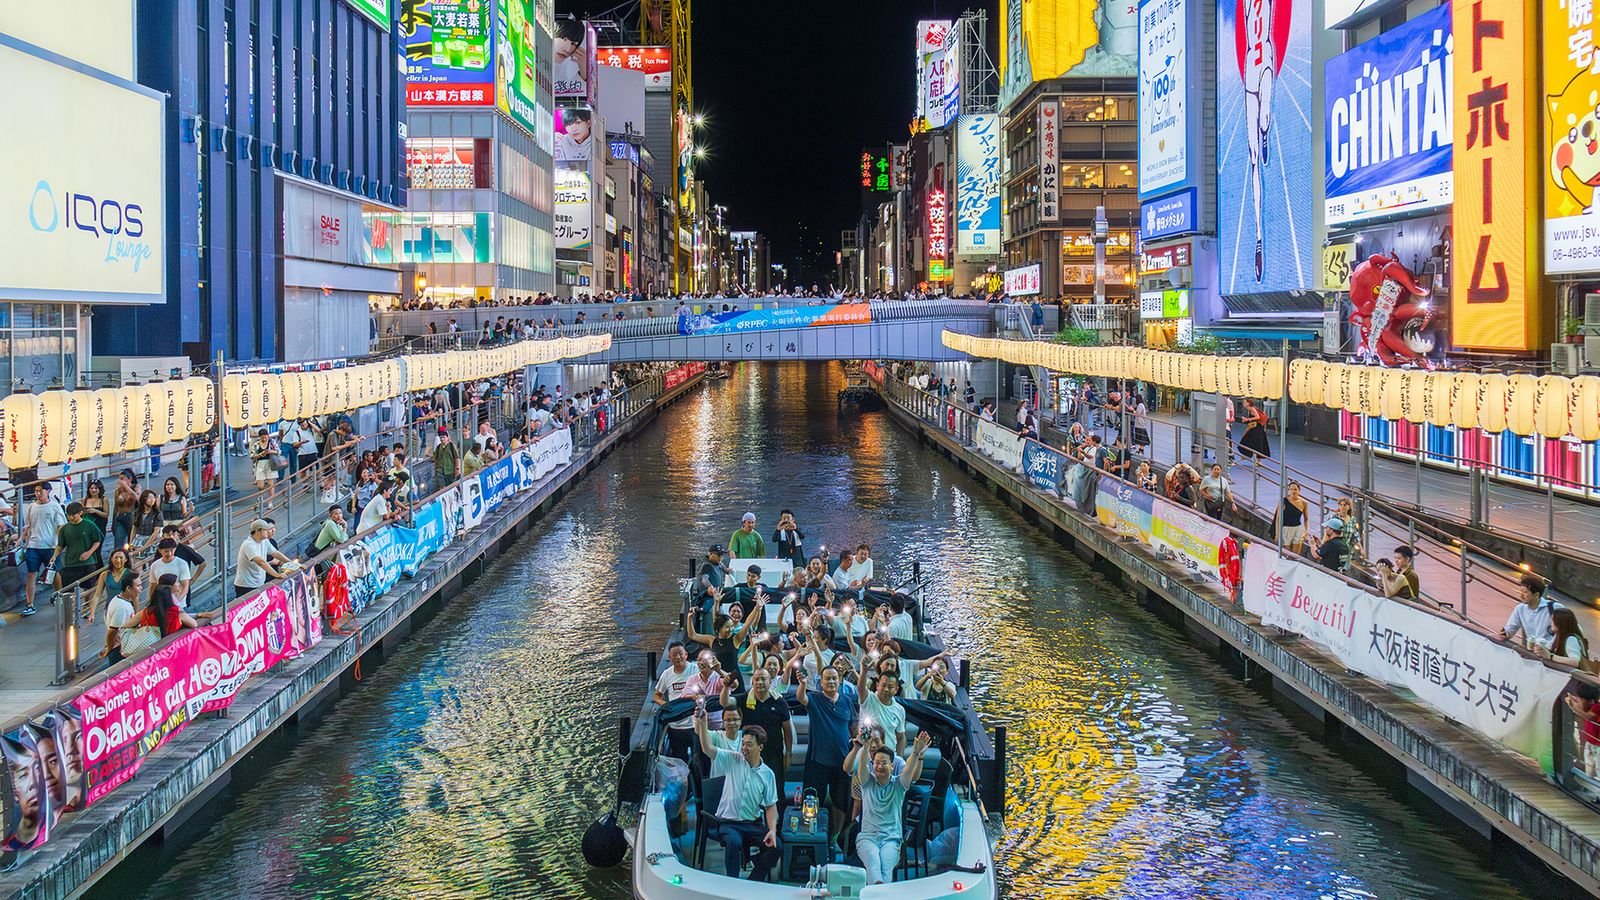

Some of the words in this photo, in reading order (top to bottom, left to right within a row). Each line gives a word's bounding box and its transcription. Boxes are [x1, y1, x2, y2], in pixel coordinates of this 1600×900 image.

[608, 54, 642, 69] 免税
[66, 191, 144, 239] IQOS
[320, 215, 340, 231] SALE
[105, 227, 152, 274] Lounge
[725, 341, 797, 354] えびす橋
[241, 381, 249, 420] PABLO
[1369, 623, 1519, 723] 大阪樟蔭女子大学
[132, 683, 143, 699] to
[148, 694, 163, 724] is
